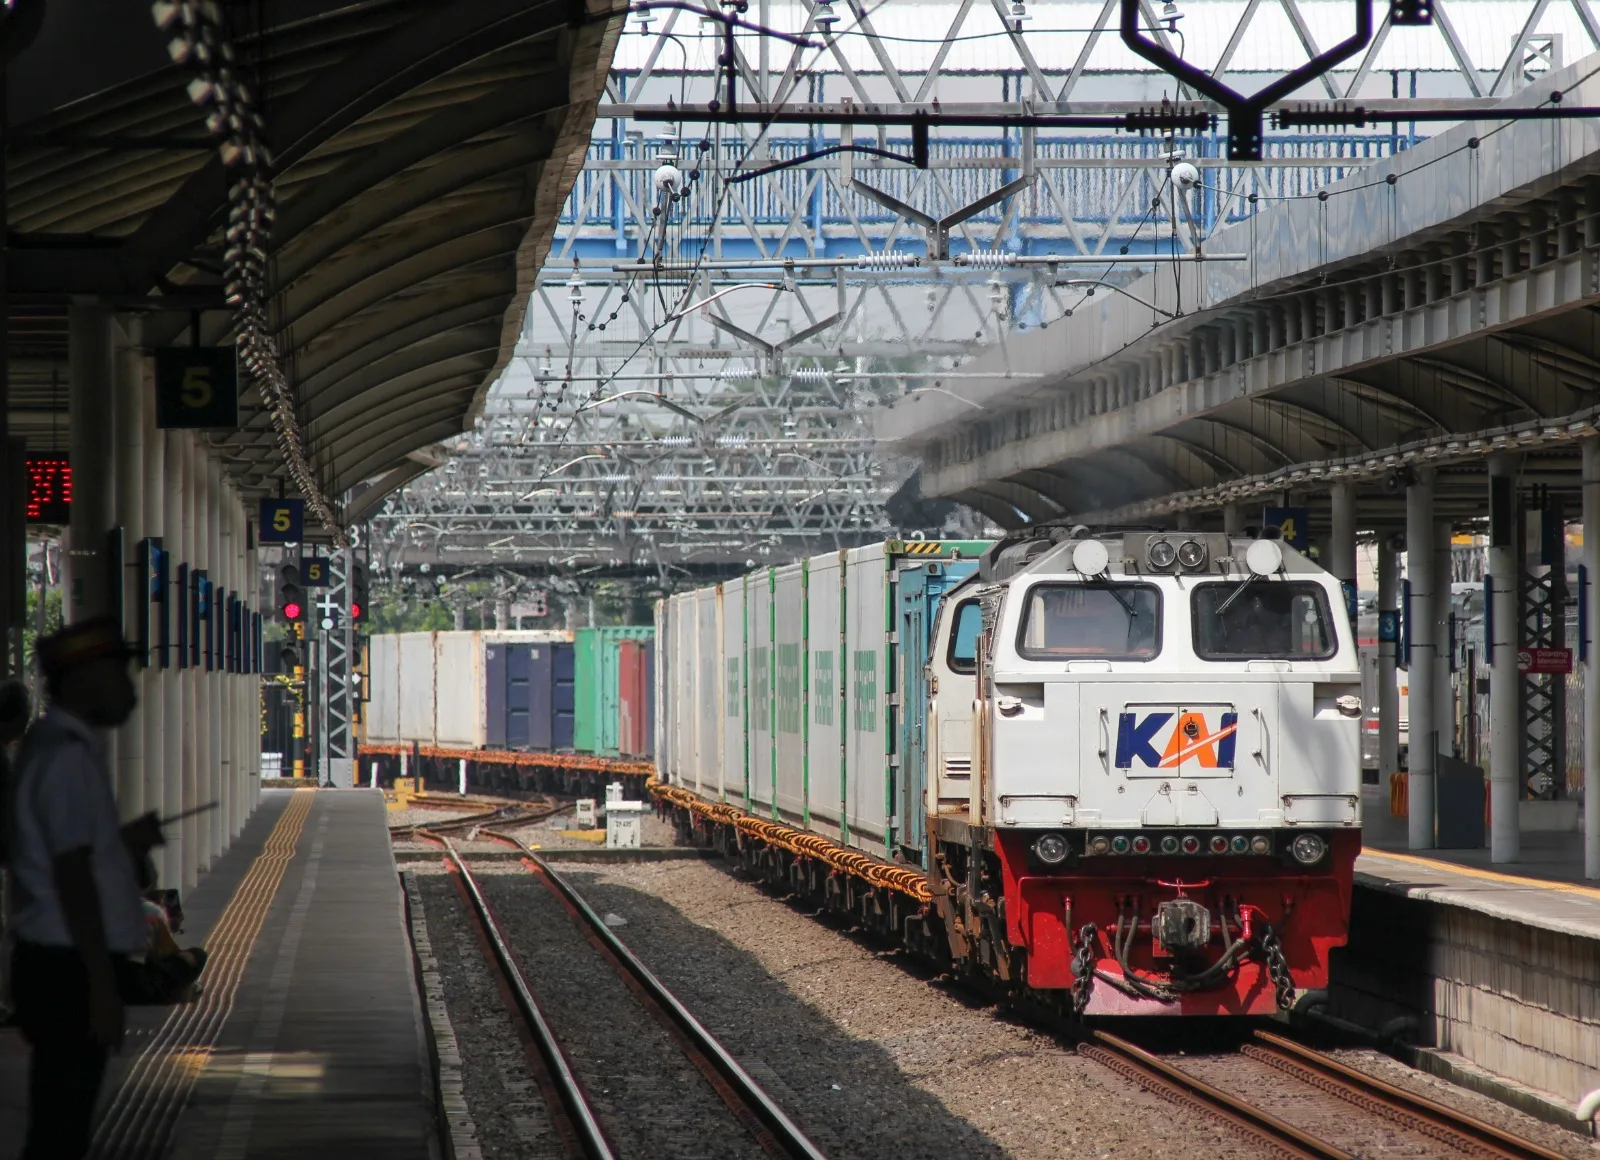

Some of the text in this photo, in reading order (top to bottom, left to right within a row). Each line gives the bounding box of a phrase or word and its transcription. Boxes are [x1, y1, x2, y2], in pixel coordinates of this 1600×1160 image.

[181, 367, 211, 408] 5
[273, 509, 291, 531] 5
[1280, 518, 1297, 540] 4
[309, 564, 320, 580] 5
[1385, 617, 1394, 633] 3
[1115, 713, 1238, 768] KAI
